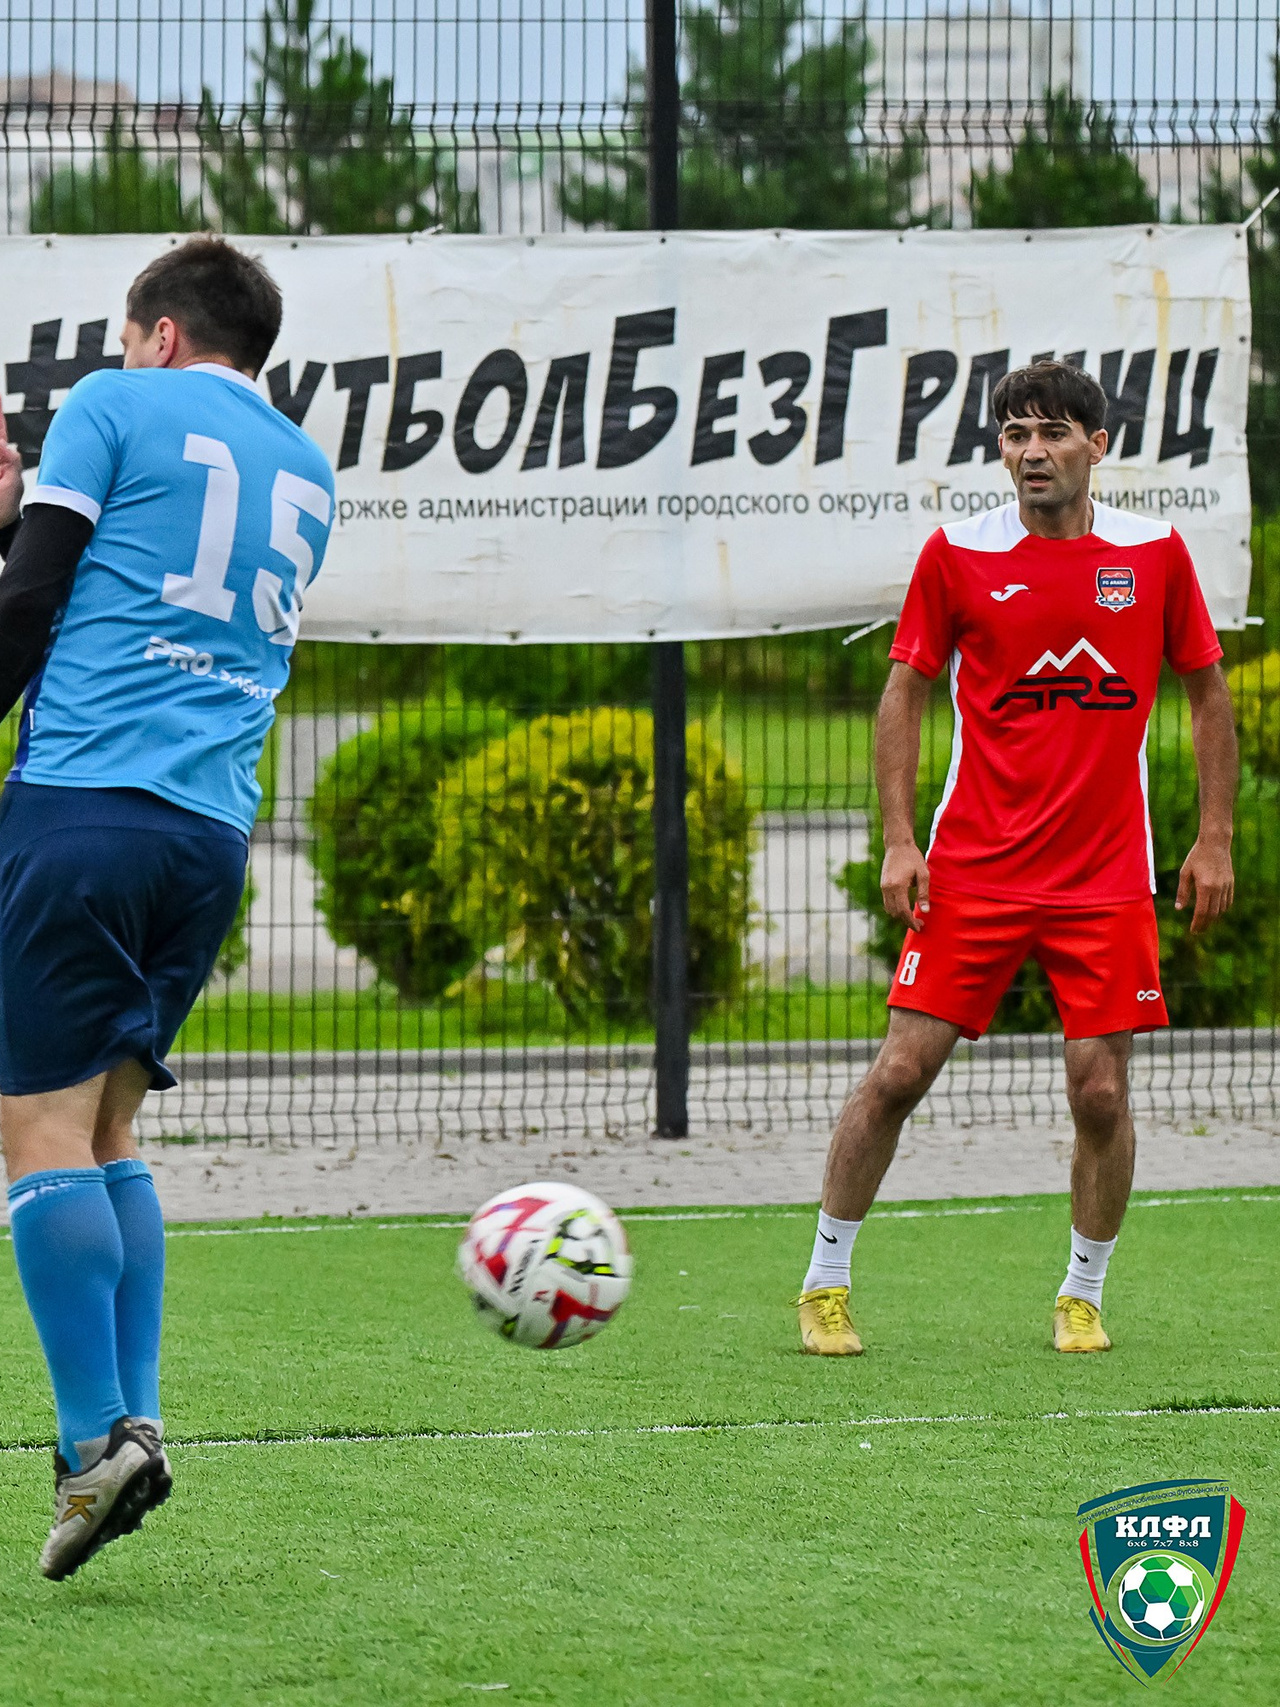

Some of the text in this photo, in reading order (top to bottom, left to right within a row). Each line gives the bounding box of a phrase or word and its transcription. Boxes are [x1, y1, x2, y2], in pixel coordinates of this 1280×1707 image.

[333, 499, 407, 526] ржке
[419, 493, 648, 525] администрации
[657, 493, 810, 522] городского
[820, 491, 909, 520] округа
[1090, 486, 1220, 516] нинград»
[161, 432, 331, 647] 15
[989, 675, 1138, 711] ARS
[898, 950, 921, 986] 8
